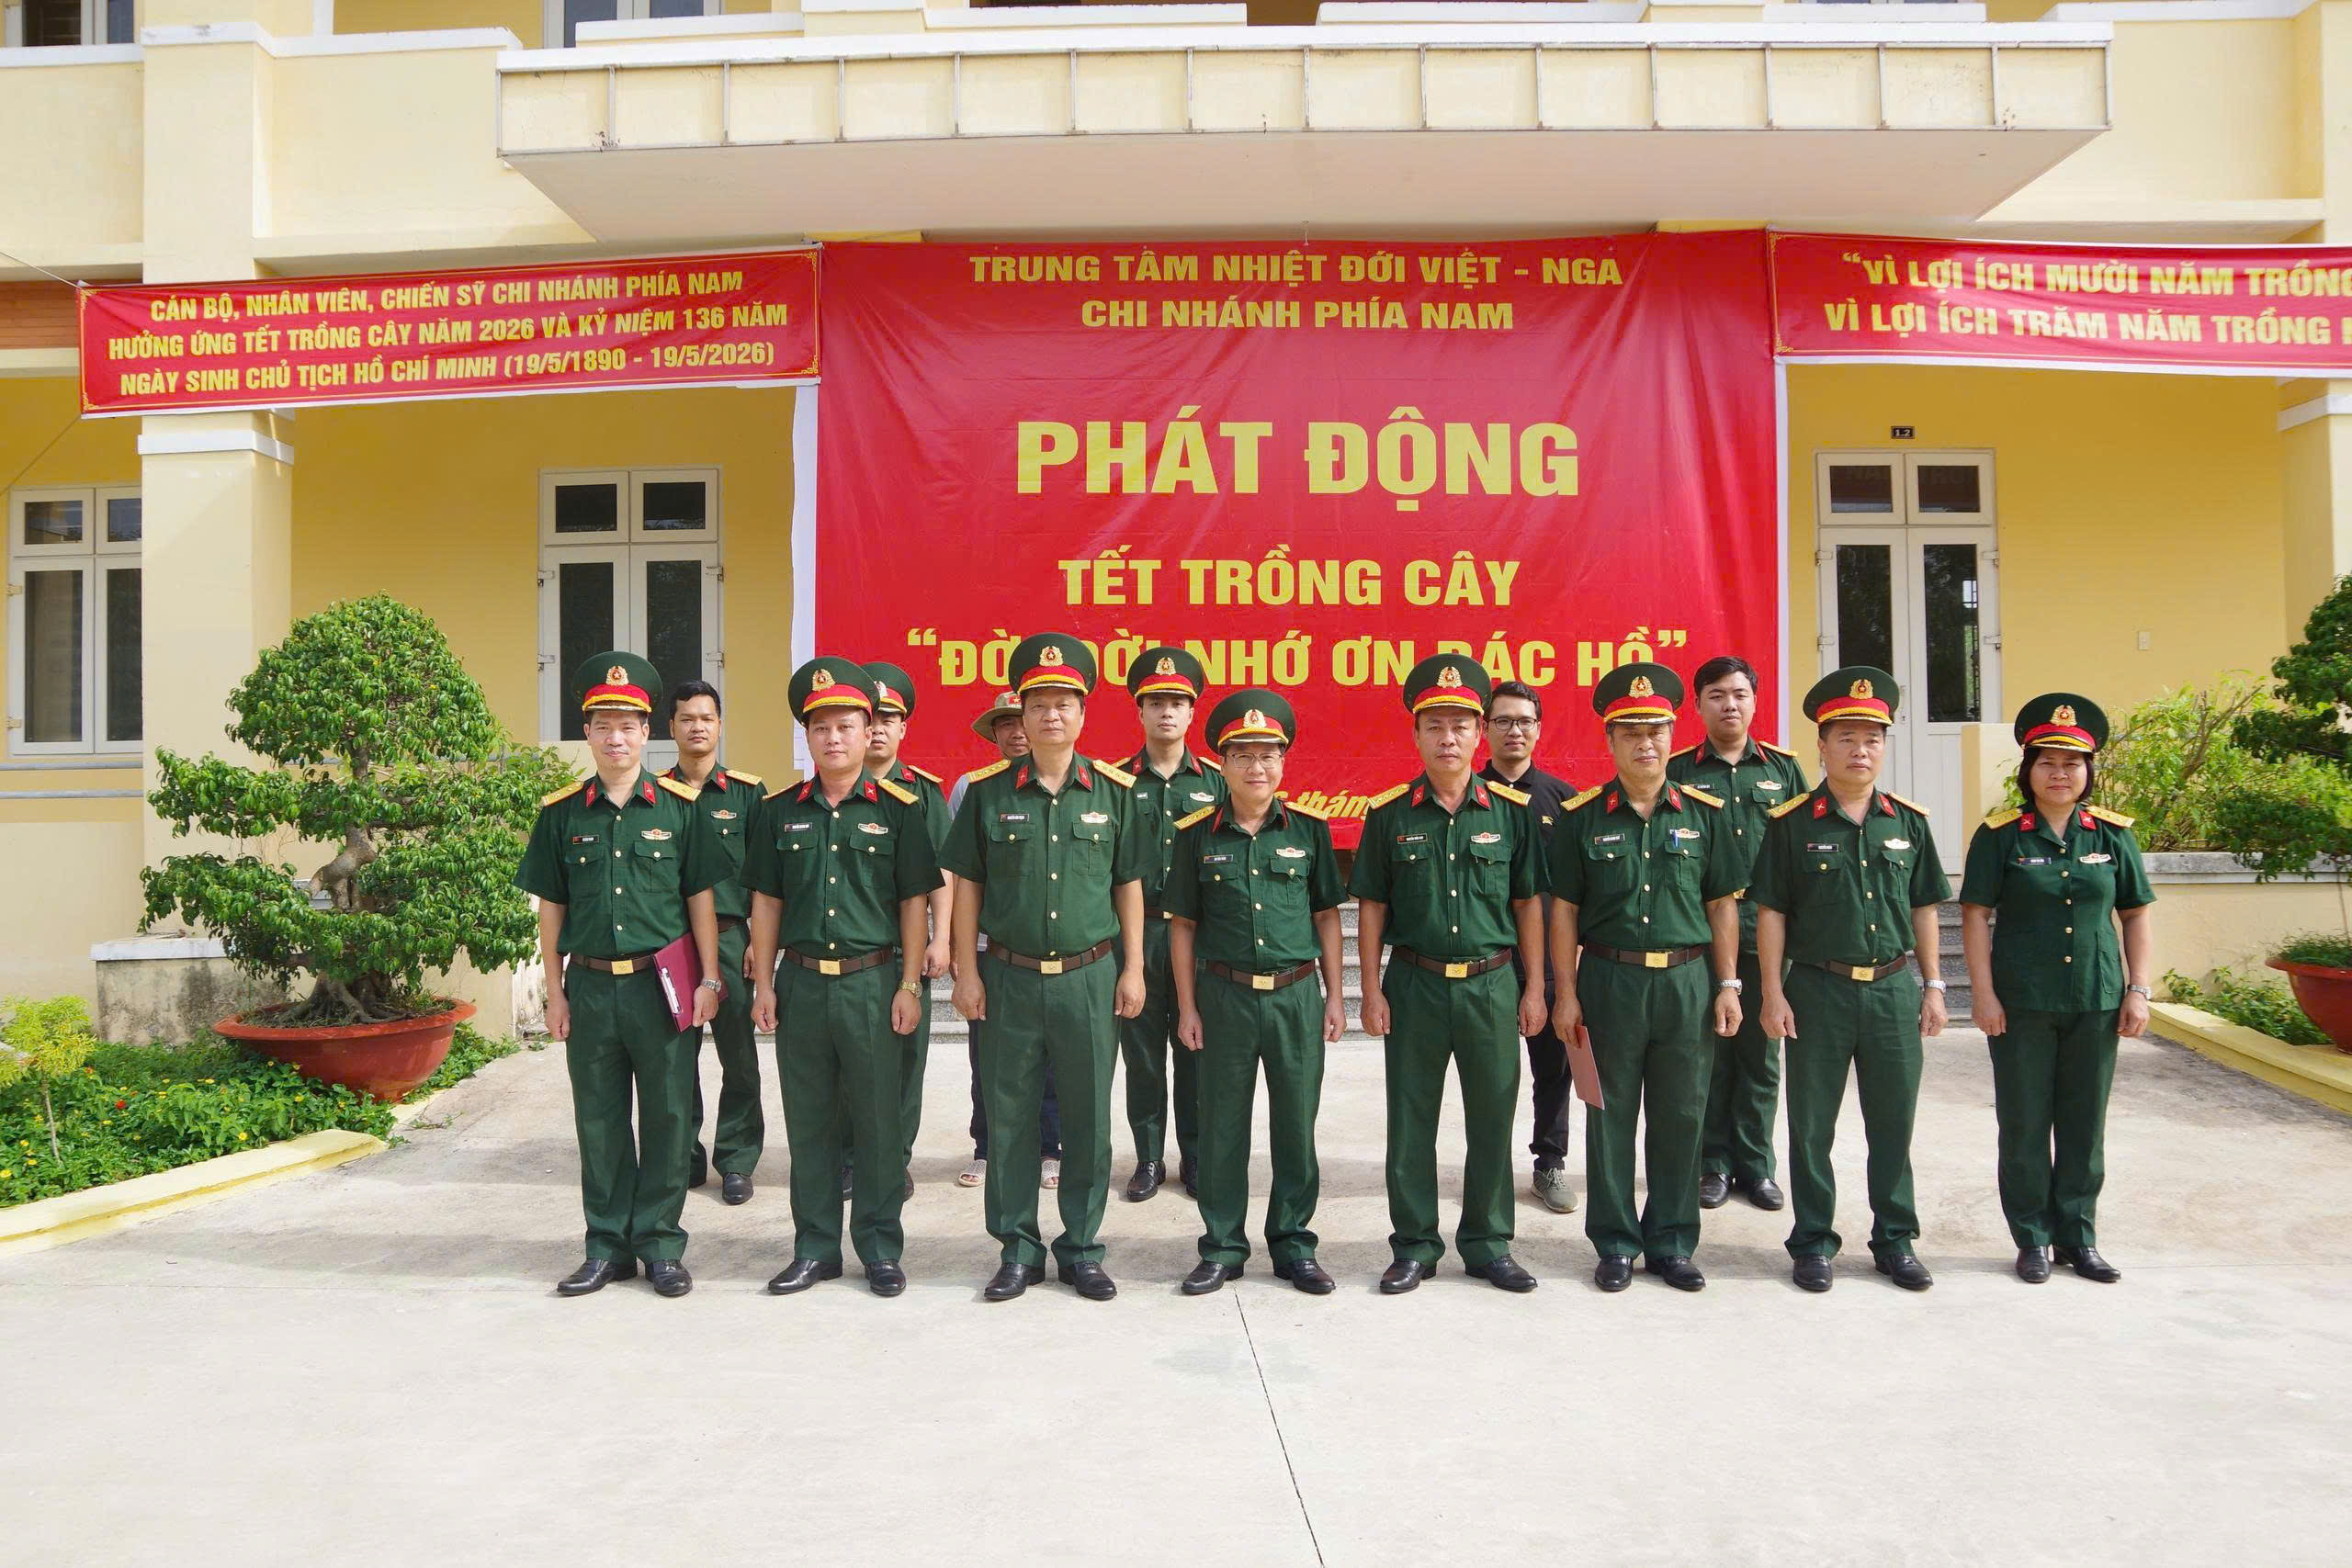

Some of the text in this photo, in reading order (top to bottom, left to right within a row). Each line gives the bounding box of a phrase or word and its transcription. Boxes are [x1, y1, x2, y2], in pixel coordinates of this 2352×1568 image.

[969, 255, 1100, 282] TRUNG
[1113, 250, 1198, 281] TÂM
[1213, 249, 1328, 288] NHIỆT
[1339, 250, 1406, 283] ĐỚI
[1419, 251, 1500, 289] VIỆT
[1543, 257, 1623, 285] NGA
[1843, 252, 1899, 285] “VÌ
[1908, 258, 1963, 293] LỢI
[1975, 257, 2034, 291] ÍCH
[2046, 259, 2139, 293] MƯỜI
[2150, 261, 2234, 295] NĂM
[151, 271, 743, 322] CÁN BỘ, NHÂN VIÊN, CHIẾN SỸ CHI NHÁNH PHÍA NAM
[1081, 295, 1514, 330] CHI NHÁNH PHÍA NAM
[1824, 298, 1860, 331] VÌ
[1871, 302, 1928, 338] LỢI
[1939, 300, 1998, 334] ÍCH
[2007, 306, 2109, 340] TRĂM
[2118, 309, 2201, 343] NĂM
[108, 301, 787, 360] HƯỞNG ỨNG TẾT TRỒNG CÂY NĂM 2026 VÀ KỶ NIỆM 136 NĂM
[120, 368, 179, 396] NGÀY
[186, 368, 239, 392] SINH
[245, 359, 290, 388] CHỦ
[297, 363, 348, 391] TỊCH
[354, 355, 384, 384] HỒ
[391, 355, 430, 382] CHÍ
[435, 355, 498, 379] MINH
[504, 348, 627, 378] (19/5/1890
[650, 342, 775, 368] 19/5/2026)
[1017, 404, 1579, 512] PHÁT ĐỘNG
[1057, 543, 1521, 606] TẾT TRỒNG CÂY
[907, 627, 1022, 686] “ĐỜ
[1184, 629, 1312, 686] NHỚ
[1331, 635, 1415, 686] ƠN
[1295, 789, 1368, 820] thán
